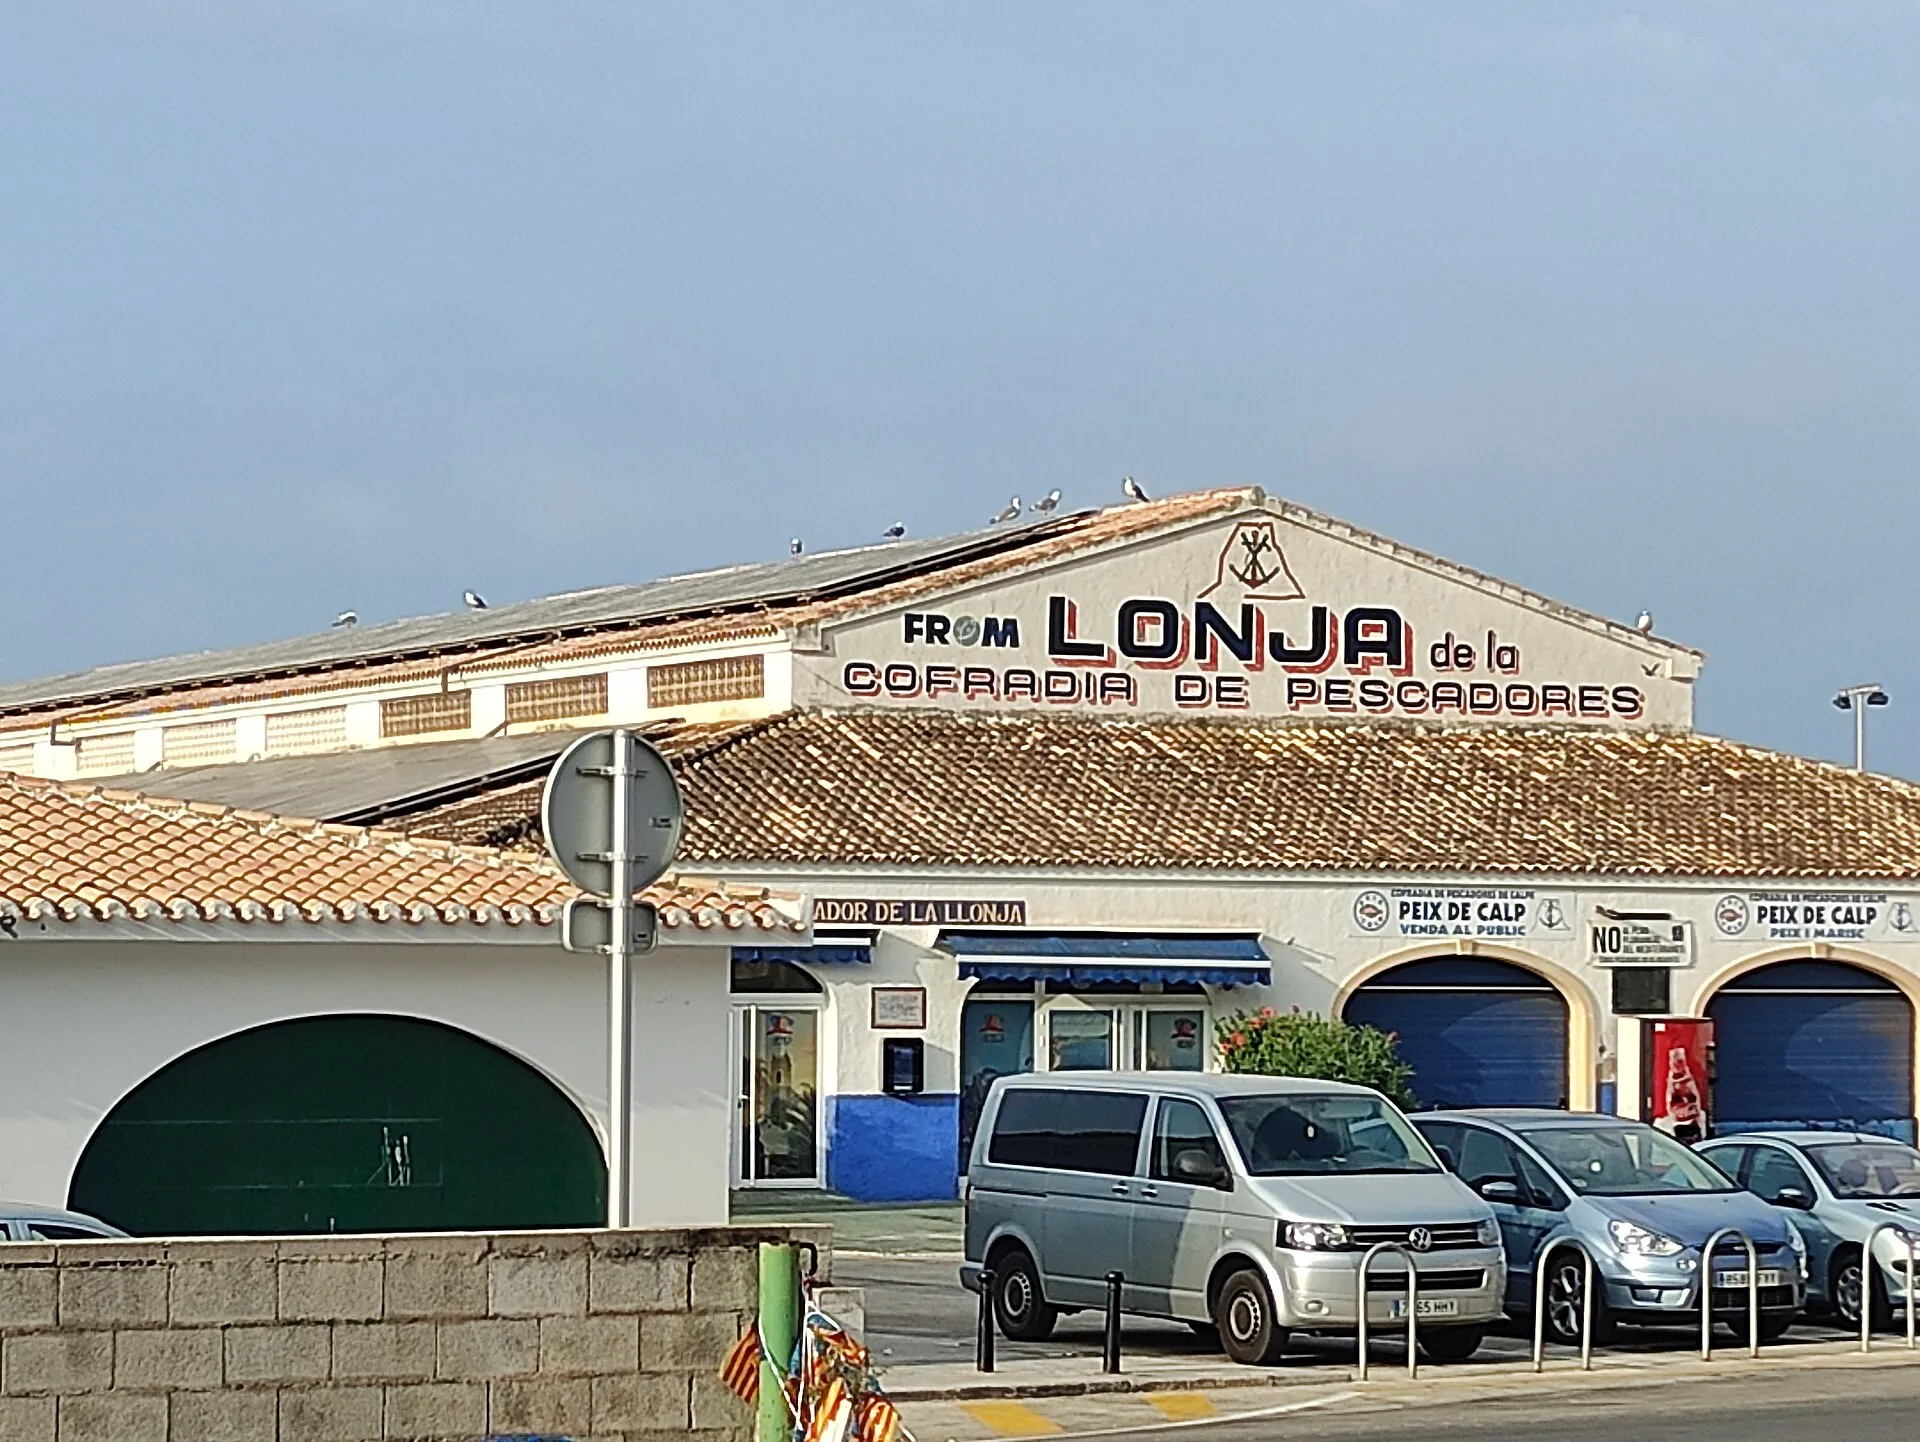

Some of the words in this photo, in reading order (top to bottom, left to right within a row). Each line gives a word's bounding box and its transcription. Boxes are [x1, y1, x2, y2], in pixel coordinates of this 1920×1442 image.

[1048, 596, 1412, 676] LONJA
[1430, 631, 1476, 672] de
[1487, 629, 1519, 673] la
[843, 662, 1137, 707] COFRADIA
[1175, 674, 1249, 709] DE
[1287, 677, 1643, 721] PESCADORES
[814, 901, 868, 921] ADOR
[875, 901, 903, 922] DE
[910, 902, 937, 922] LA
[944, 903, 1022, 923] LLONJA
[1400, 901, 1442, 920] PEIX
[1448, 902, 1471, 921] DE
[1477, 902, 1526, 922] CALP
[1757, 906, 1798, 924] PEIX
[1804, 906, 1826, 925] DE
[1831, 906, 1877, 925] CALP
[1400, 923, 1449, 935] VENDA
[1453, 924, 1472, 935] AL
[1477, 925, 1526, 936] PUBLIC
[1593, 926, 1620, 953] NO
[1771, 927, 1801, 938] PEIX
[1814, 928, 1864, 939] MARISC
